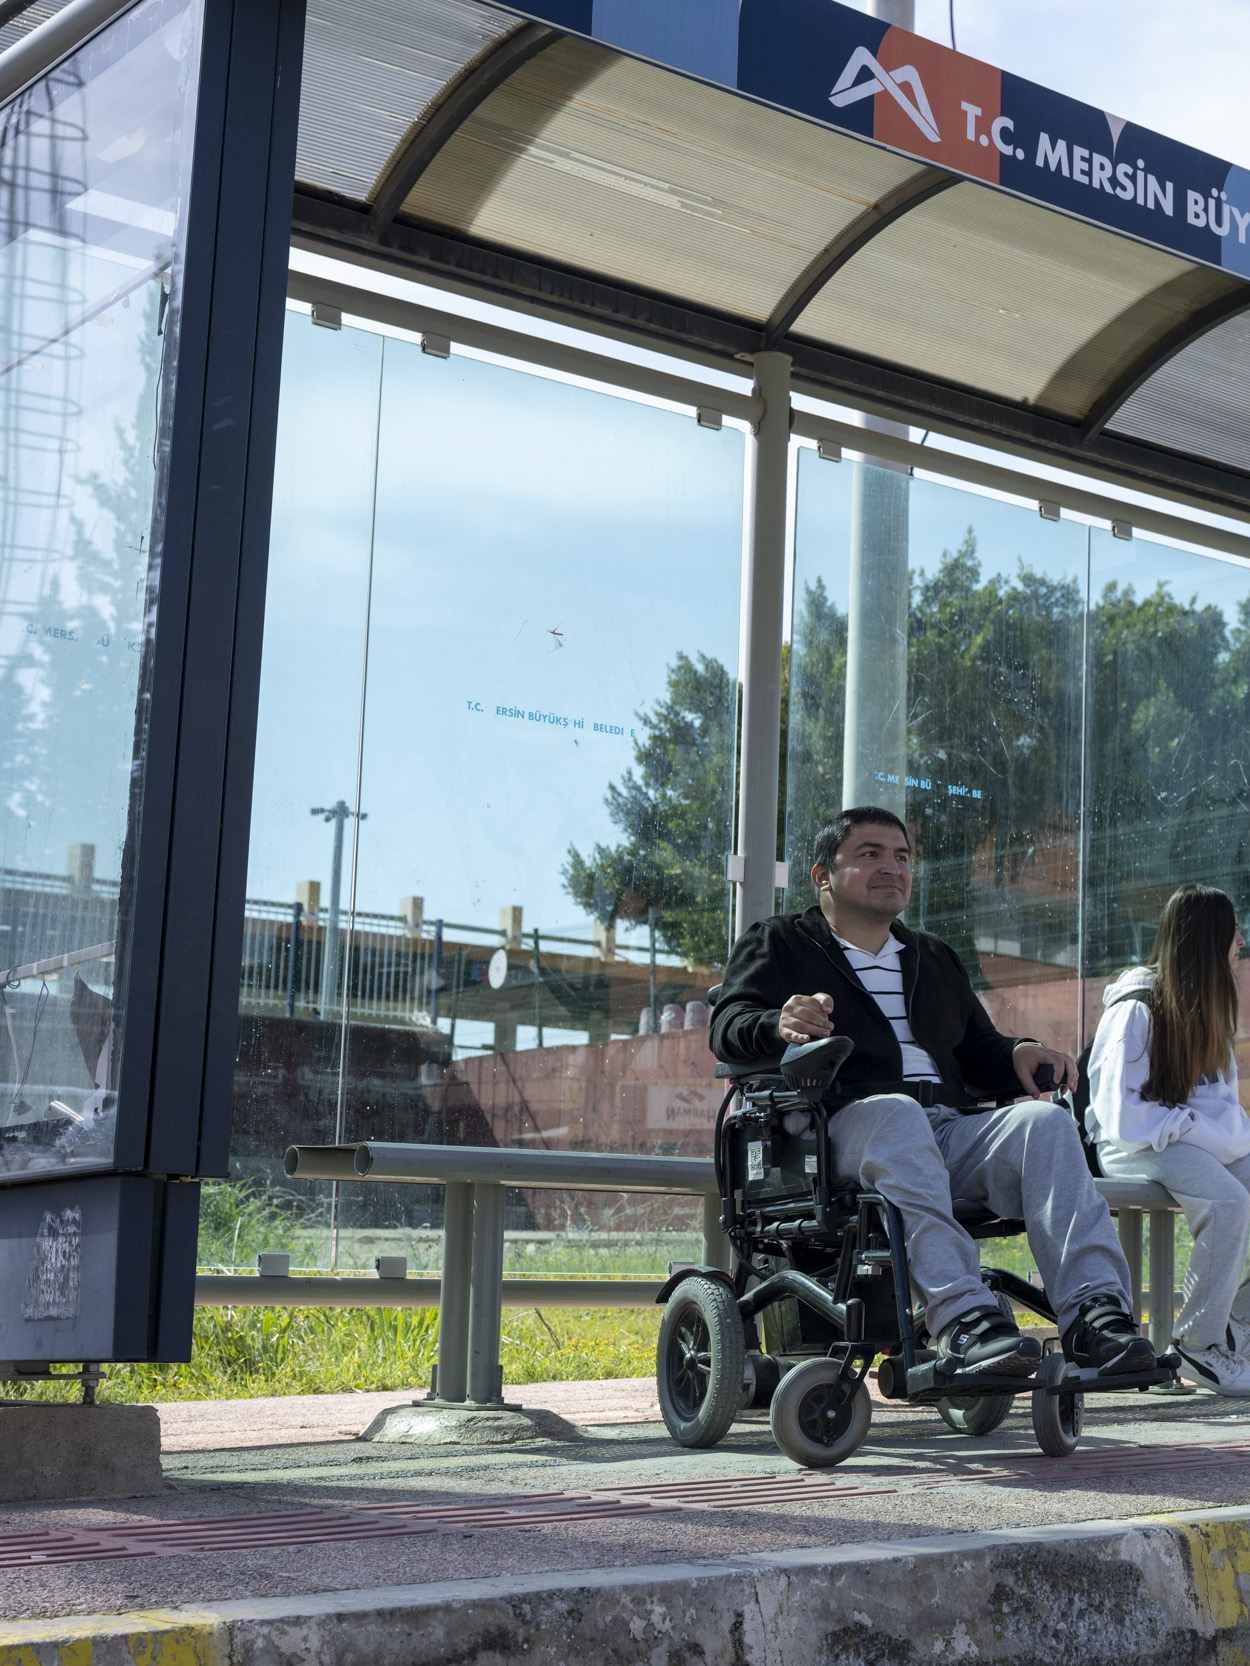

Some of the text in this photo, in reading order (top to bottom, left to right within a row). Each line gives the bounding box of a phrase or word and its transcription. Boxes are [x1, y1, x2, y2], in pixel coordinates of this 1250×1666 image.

[961, 100, 1025, 160] T.C.
[1035, 131, 1174, 218] MERSİN
[466, 700, 484, 713] T.C.
[495, 705, 525, 720] ERSİN
[527, 709, 584, 729] BÜYÜKŞHİ
[886, 774, 919, 789] MESİN
